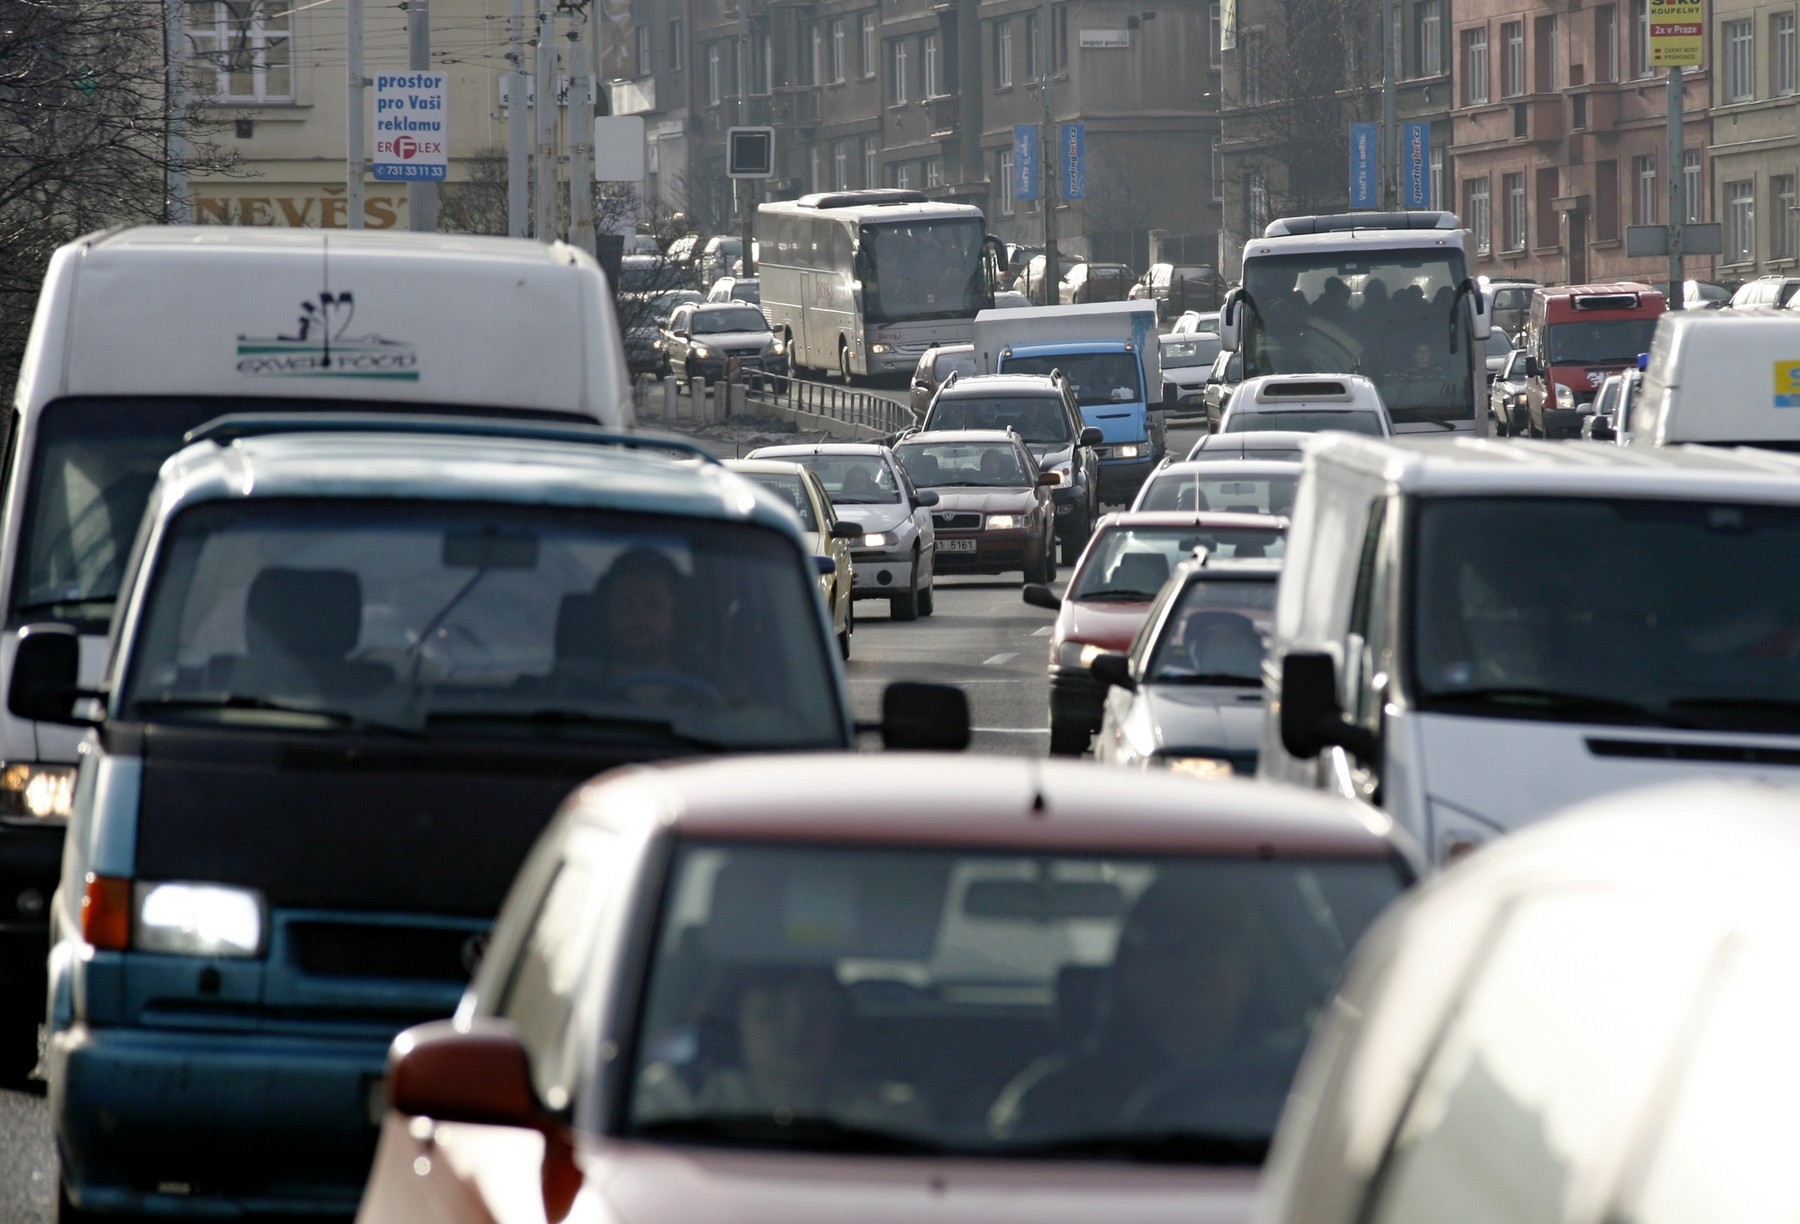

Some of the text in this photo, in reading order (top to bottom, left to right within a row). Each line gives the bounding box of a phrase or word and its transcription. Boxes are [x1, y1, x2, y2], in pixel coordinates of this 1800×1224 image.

[1655, 25, 1665, 34] 2x
[1674, 25, 1697, 33] Praze
[377, 74, 442, 92] prostor
[377, 95, 442, 113] pro Vaši
[377, 116, 441, 131] reklamu
[387, 166, 443, 176] 731 33 11 33
[1069, 127, 1080, 197] sportingbet.cz
[1411, 126, 1424, 203] sportingbet.cz
[193, 187, 407, 229] NEVĚS
[951, 541, 973, 550] 5161
